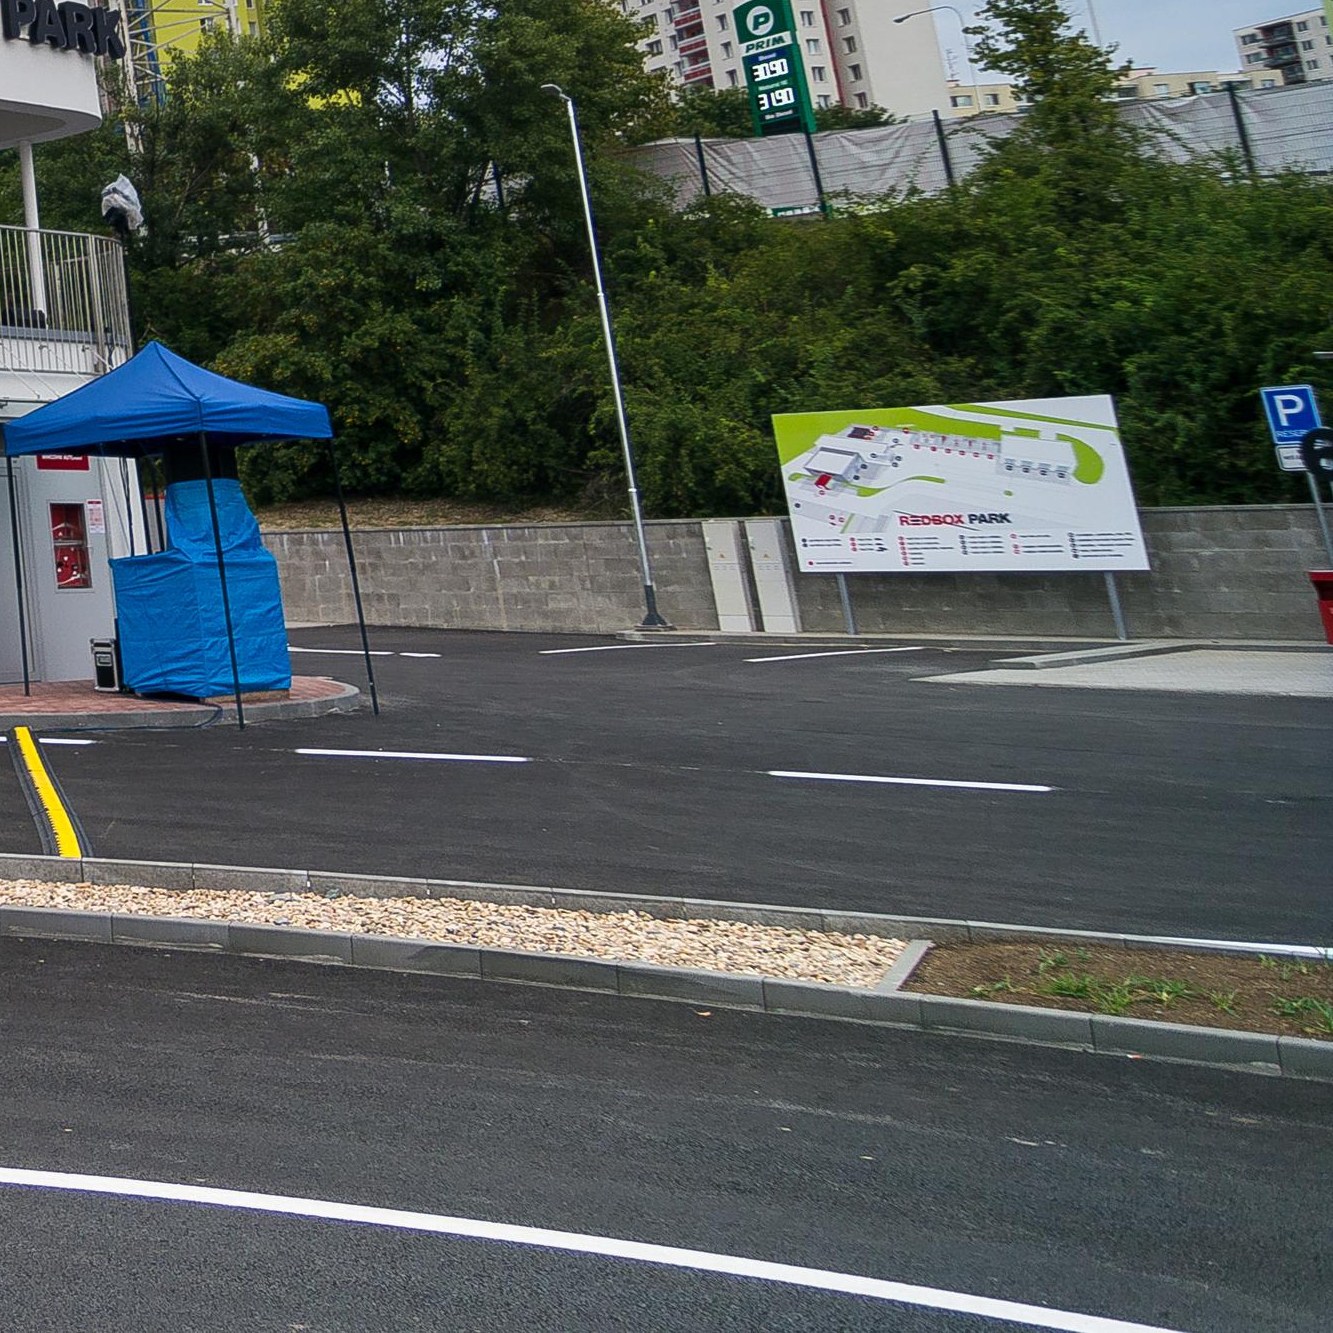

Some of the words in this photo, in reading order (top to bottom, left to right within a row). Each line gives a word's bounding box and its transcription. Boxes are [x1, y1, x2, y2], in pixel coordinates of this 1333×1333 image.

[745, 35, 786, 54] PRIM
[1273, 394, 1304, 427] P
[899, 514, 965, 526] REDBOX
[968, 512, 1013, 525] PARK
